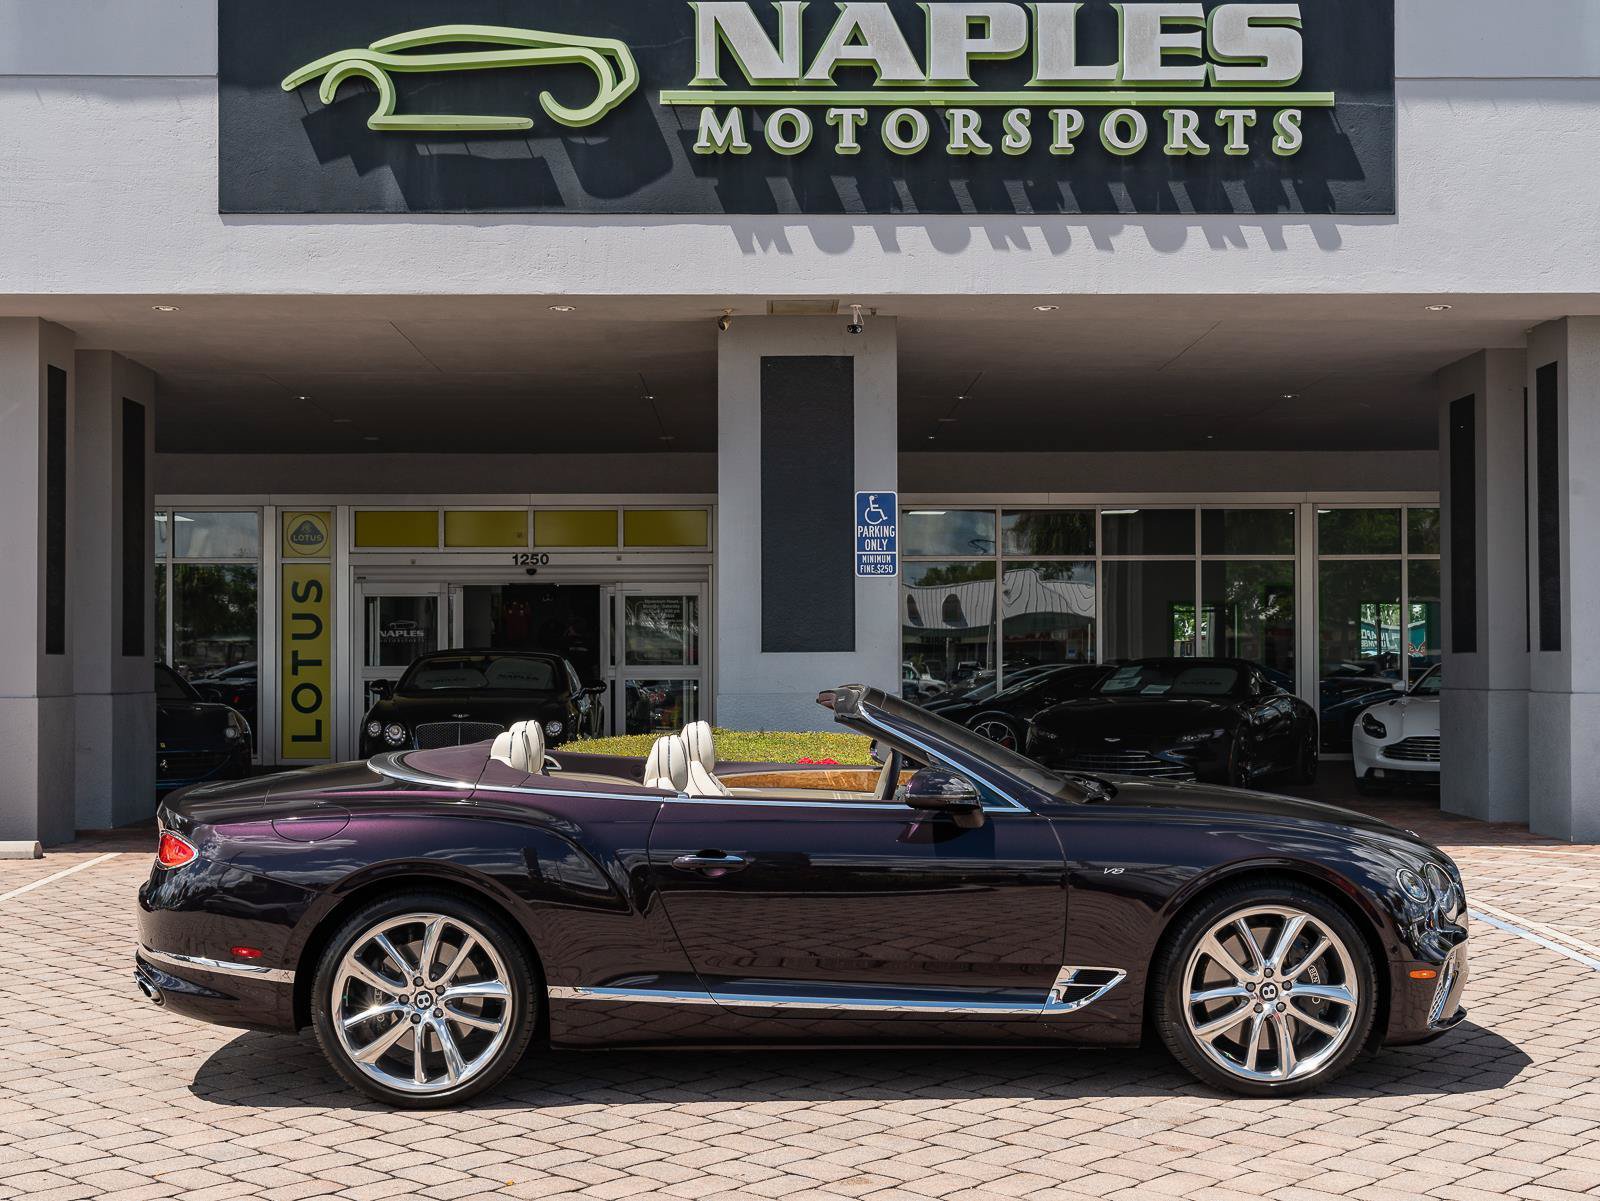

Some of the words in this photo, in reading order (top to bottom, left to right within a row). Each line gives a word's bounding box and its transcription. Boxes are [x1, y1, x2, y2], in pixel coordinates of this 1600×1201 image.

[688, 1, 1303, 87] NAPLES
[693, 107, 1303, 156] MOTORSPORTS
[858, 526, 895, 537] PARKING
[293, 534, 322, 542] LOTUS
[865, 539, 888, 550] ONLY
[512, 553, 550, 566] 1250
[862, 555, 891, 563] MINIMUM
[877, 565, 893, 573] $250
[291, 579, 323, 742] LOTUS
